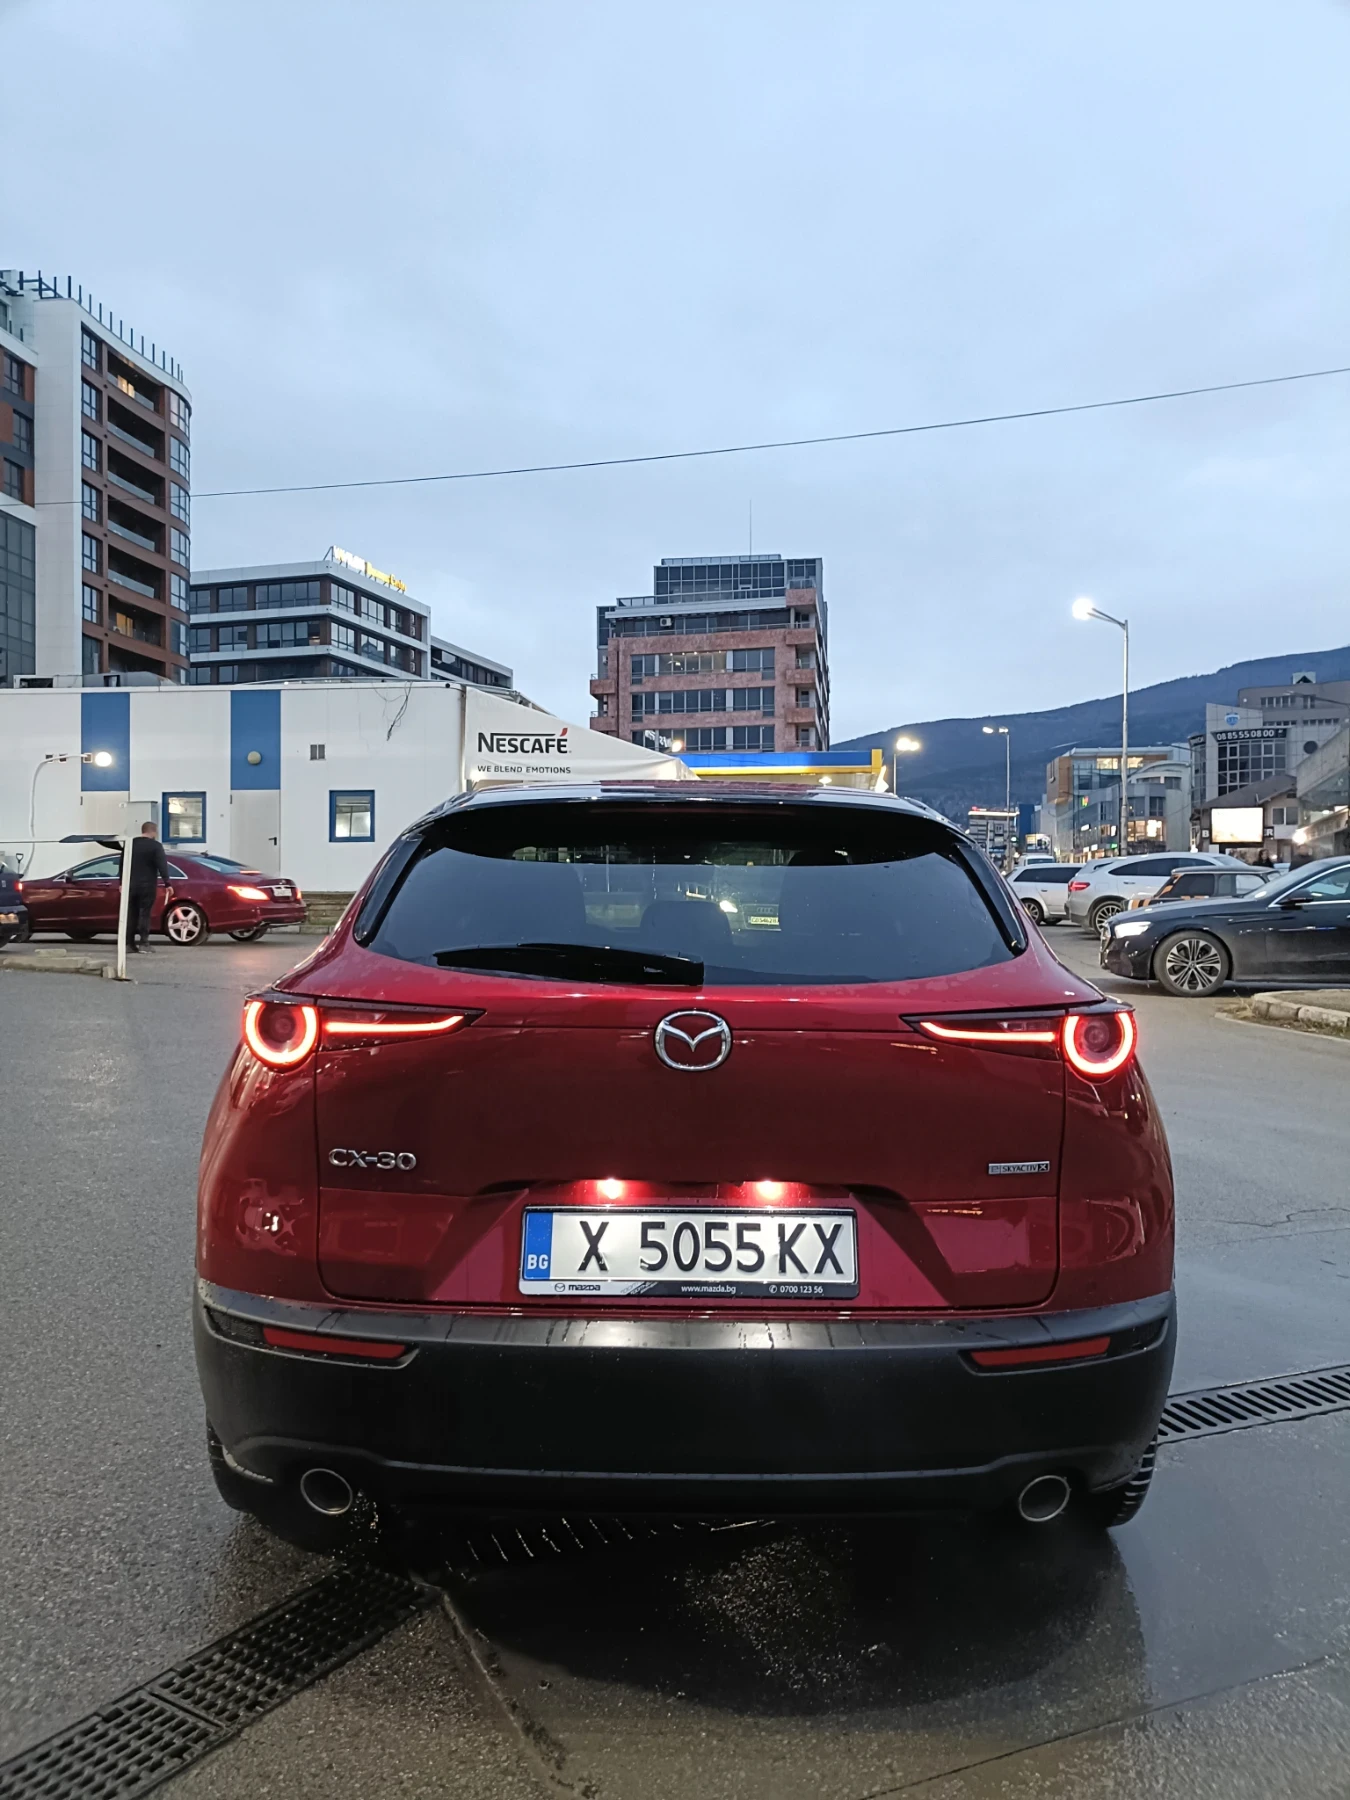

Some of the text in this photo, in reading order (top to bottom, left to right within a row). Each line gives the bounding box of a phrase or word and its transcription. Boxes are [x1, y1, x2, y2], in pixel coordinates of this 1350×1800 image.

[478, 728, 568, 753] NESCAFÉ
[478, 765, 571, 774] WE BLEND EMOTIONS
[328, 1148, 417, 1171] CX-30
[527, 1253, 549, 1270] BG
[577, 1220, 610, 1275] X
[639, 1220, 765, 1273] 5055
[681, 1284, 737, 1295] www.mazda.bg
[780, 1285, 824, 1294] 0700 123 56
